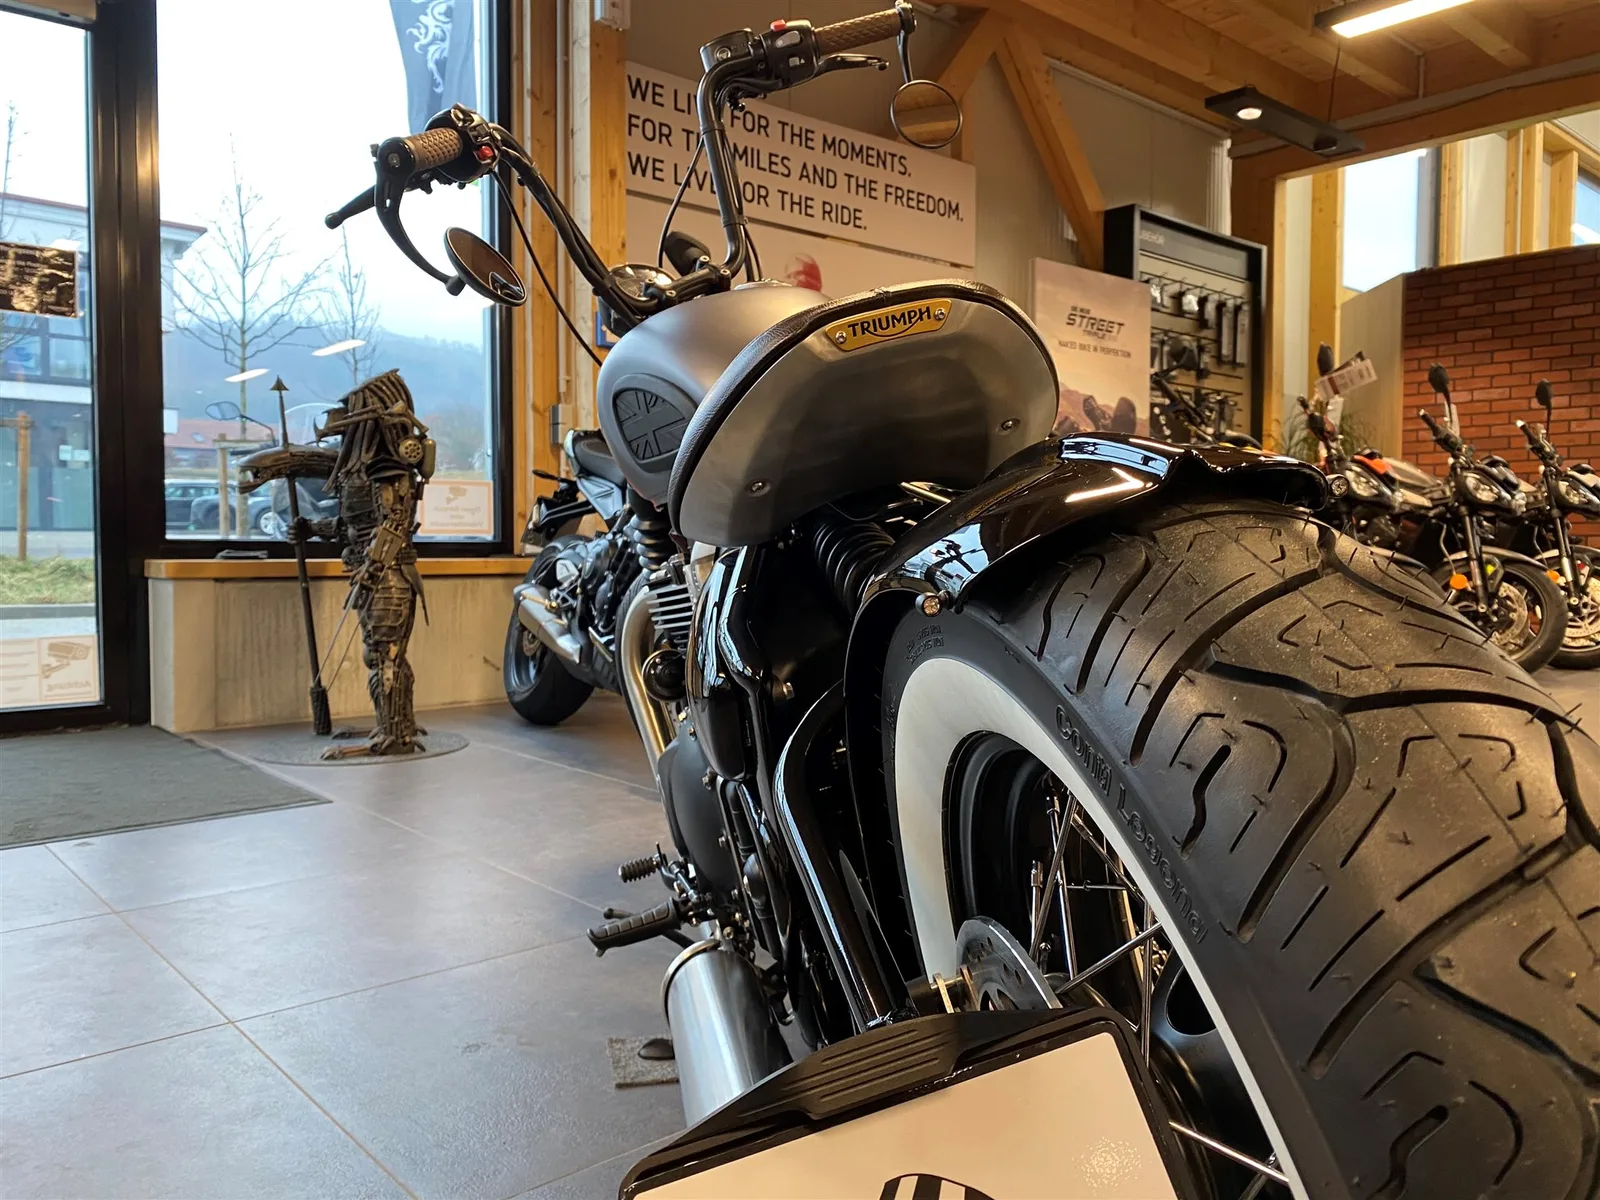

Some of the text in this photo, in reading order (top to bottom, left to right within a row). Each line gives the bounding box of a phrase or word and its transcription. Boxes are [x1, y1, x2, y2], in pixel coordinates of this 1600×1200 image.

[627, 74, 912, 178] WE LI FOR THE MOMENTS.
[627, 113, 673, 147] FOR
[733, 142, 791, 178] MILES
[798, 162, 837, 189] AND
[844, 173, 878, 200] THE
[884, 183, 964, 222] FREEDOM.
[627, 151, 665, 183] WE
[742, 181, 769, 207] OR
[777, 189, 815, 218] THE
[821, 200, 867, 230] RIDE.
[848, 306, 932, 338] TRIUMPH
[1066, 312, 1125, 335] STREET
